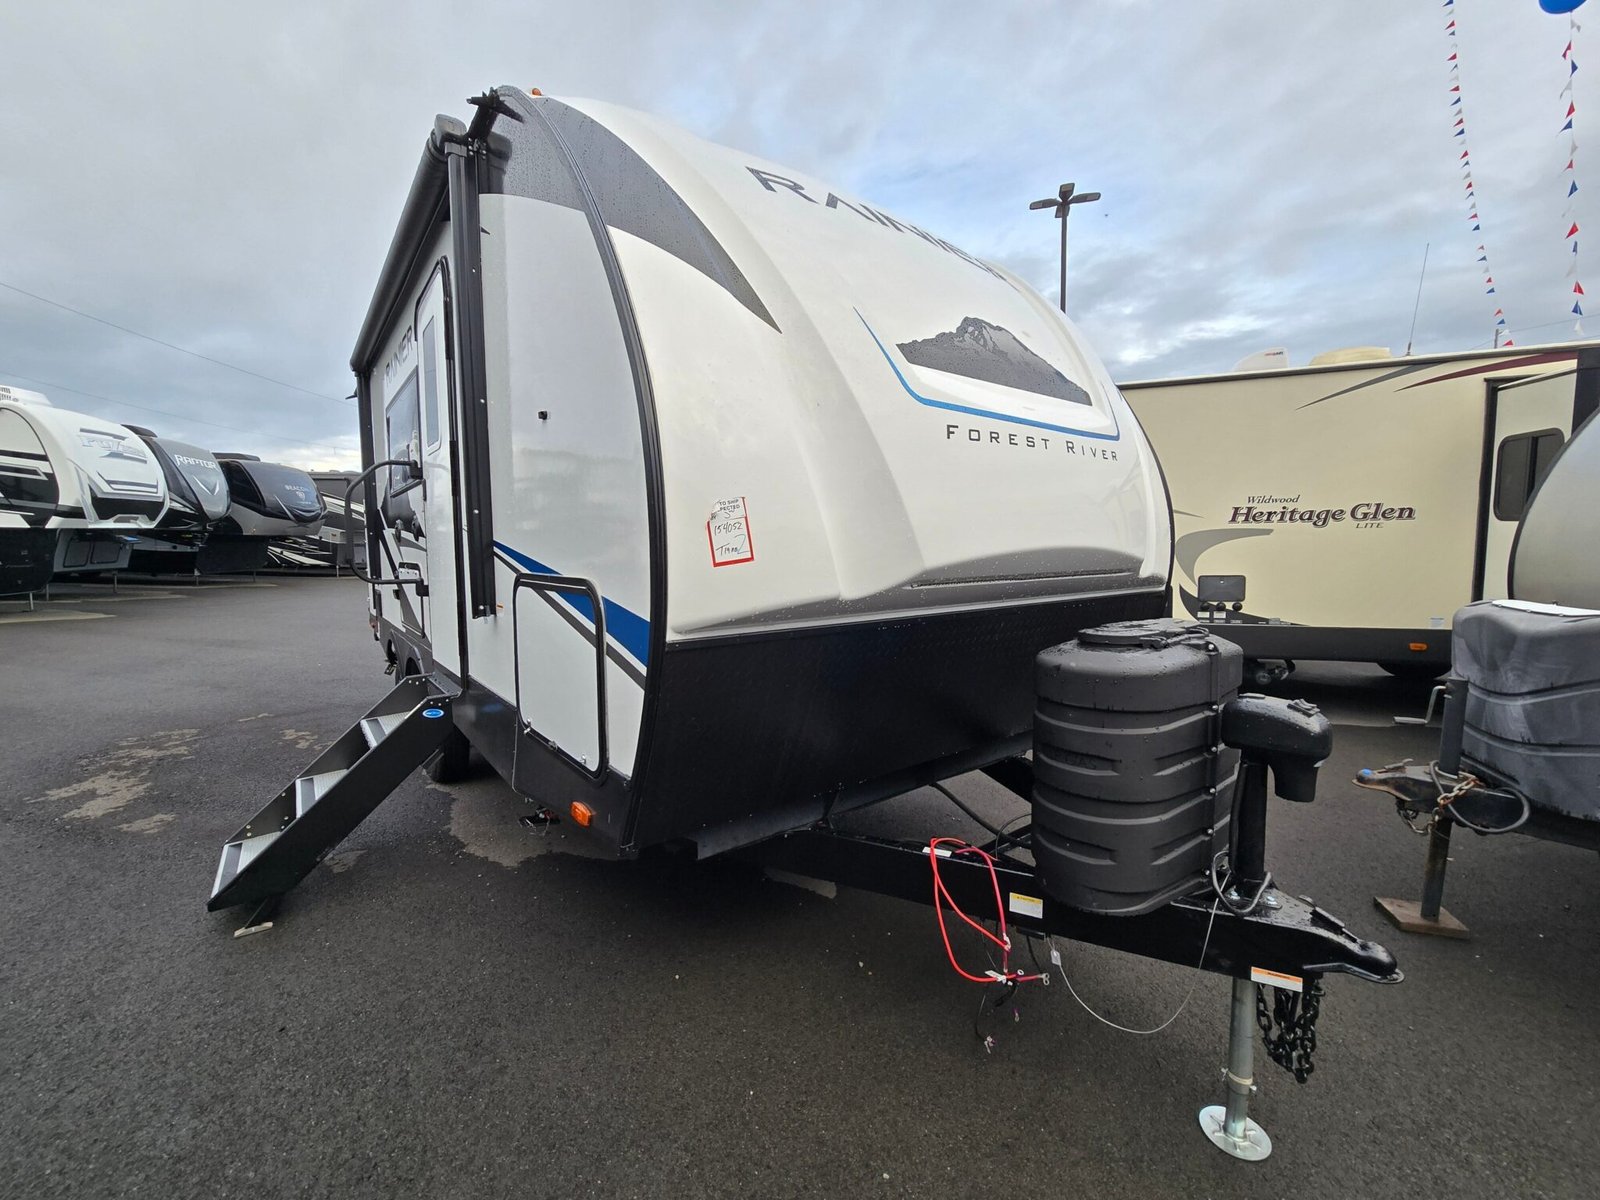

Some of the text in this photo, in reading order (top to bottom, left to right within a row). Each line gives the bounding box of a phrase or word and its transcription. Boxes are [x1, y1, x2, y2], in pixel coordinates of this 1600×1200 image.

[946, 424, 1118, 462] FOREST RIVER
[174, 454, 219, 470] RAPTOR
[1246, 494, 1301, 504] Wildwood
[1228, 502, 1416, 528] Heritage Glen
